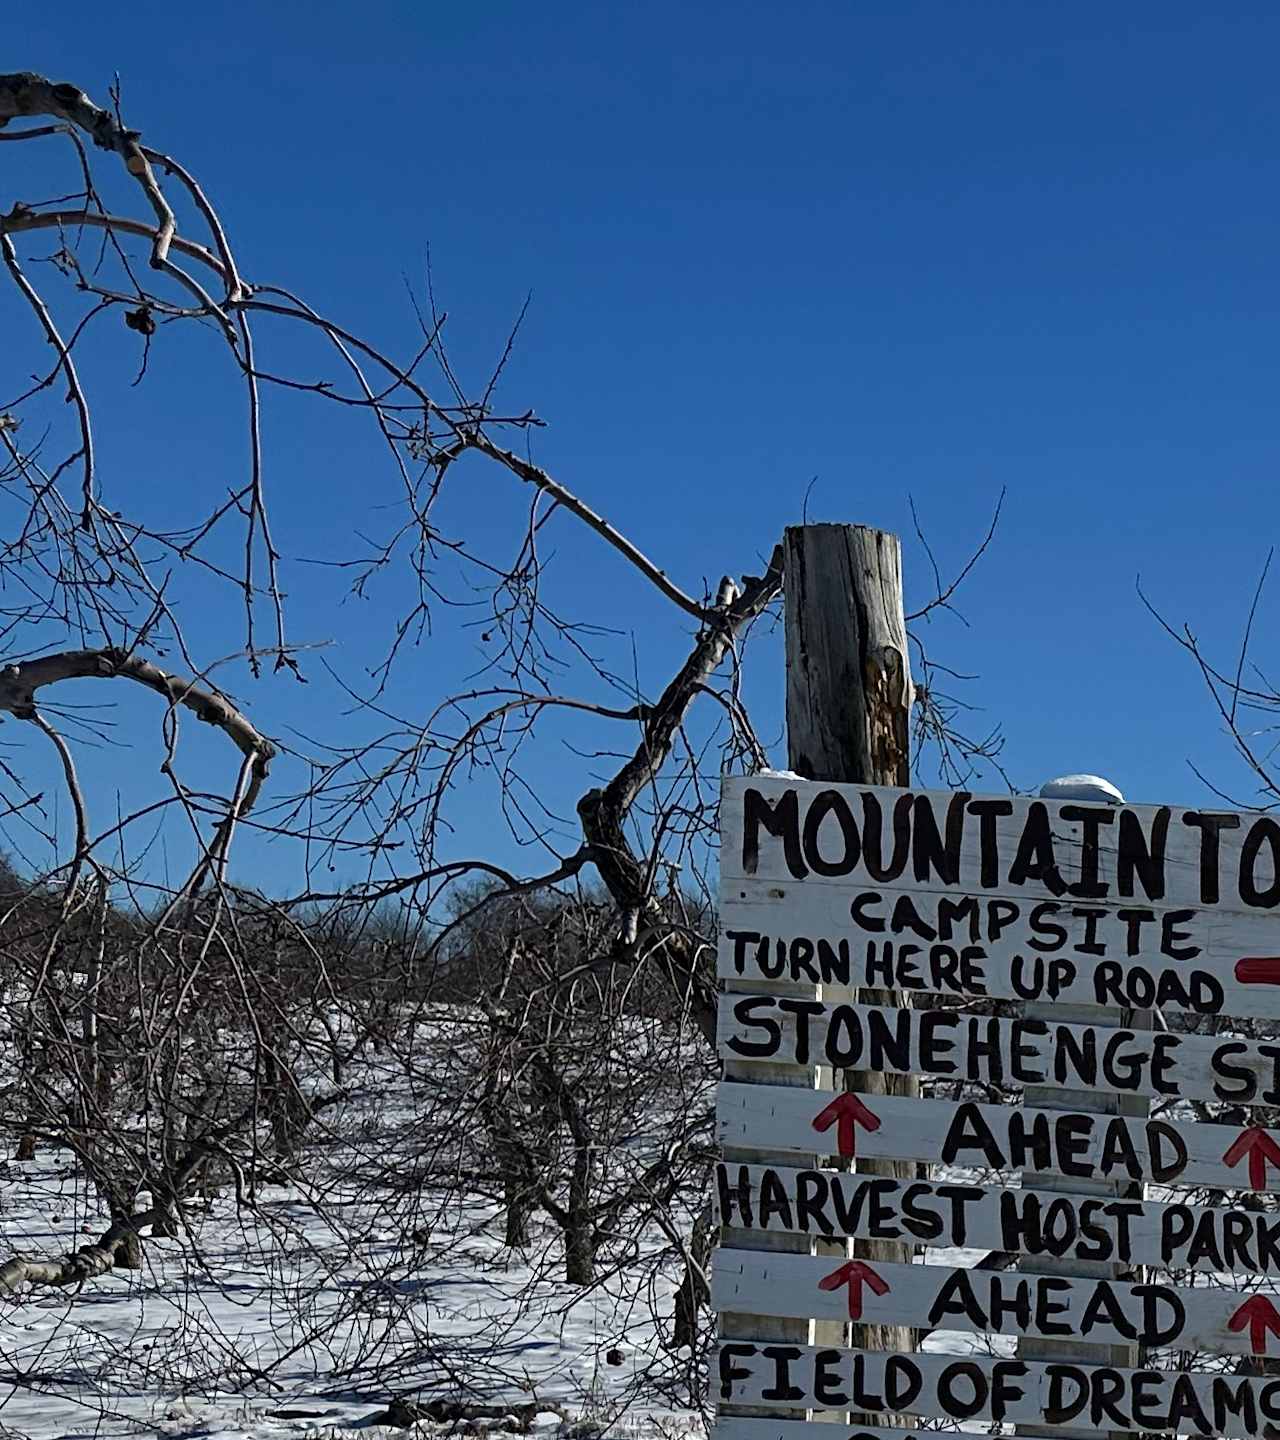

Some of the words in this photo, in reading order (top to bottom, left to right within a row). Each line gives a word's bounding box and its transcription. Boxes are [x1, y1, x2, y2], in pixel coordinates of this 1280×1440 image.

[742, 789, 1170, 901] MOUNTAIN
[850, 892, 1202, 960] CAMPSITE
[727, 930, 850, 985] TURN
[866, 941, 987, 997] HERE
[1010, 955, 1075, 1000] UP
[1095, 960, 1224, 1014] ROAD
[726, 996, 1182, 1095] STONEHENGE
[941, 1102, 1188, 1183] AHEAD
[715, 1162, 985, 1247] HARVEST
[1000, 1191, 1144, 1263] HOST
[928, 1269, 1185, 1347] AHEAD
[719, 1342, 922, 1411] FIELD
[937, 1360, 1029, 1420] OF
